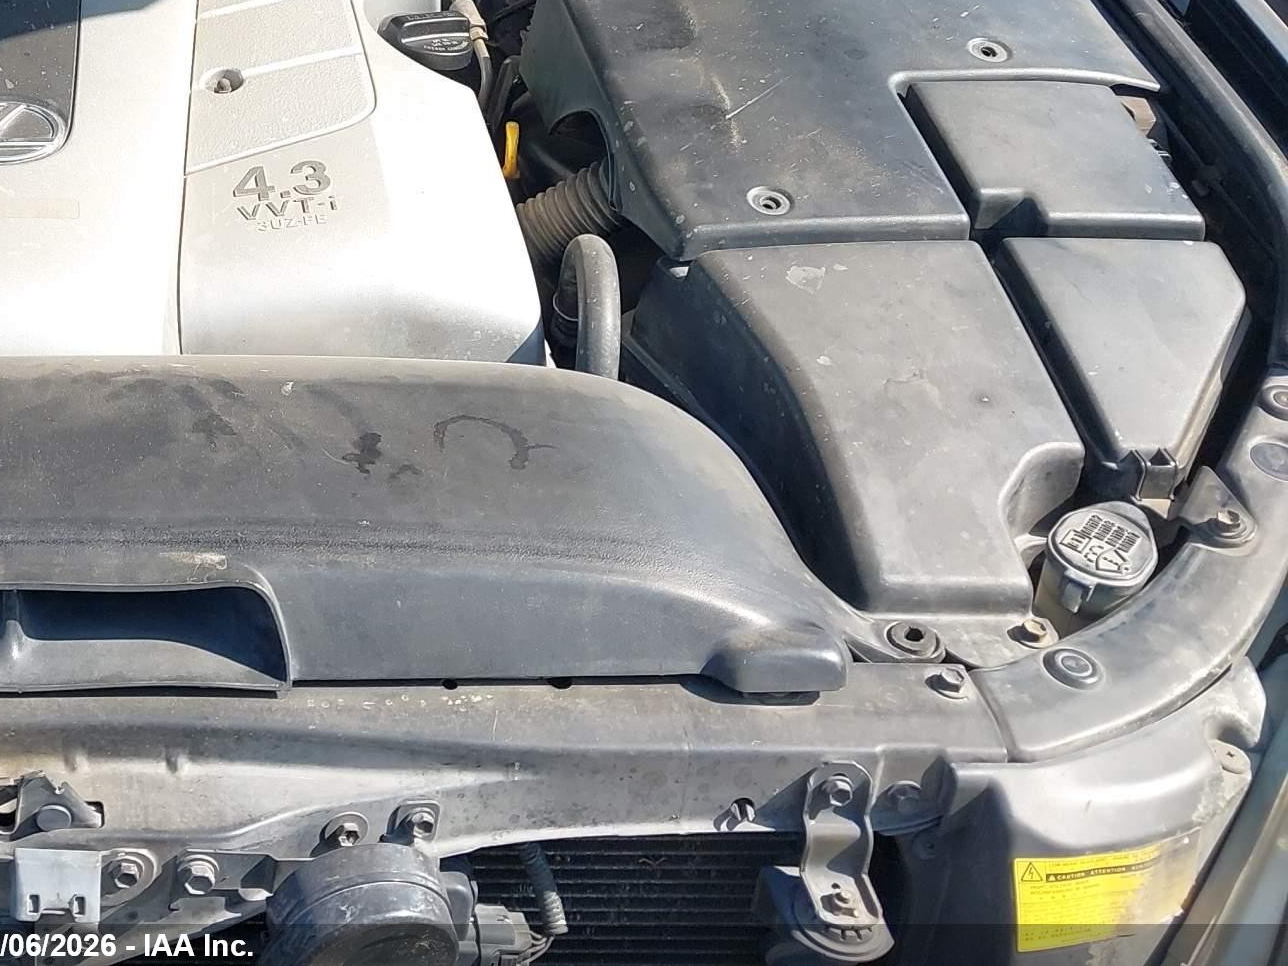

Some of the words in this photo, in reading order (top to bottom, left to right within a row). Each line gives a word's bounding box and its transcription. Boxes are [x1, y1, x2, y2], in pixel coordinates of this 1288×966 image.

[232, 160, 331, 202] 4.3
[236, 195, 338, 221] VVT-i
[1056, 872, 1086, 881] CAUTION
[1090, 867, 1126, 876] ATTENTION
